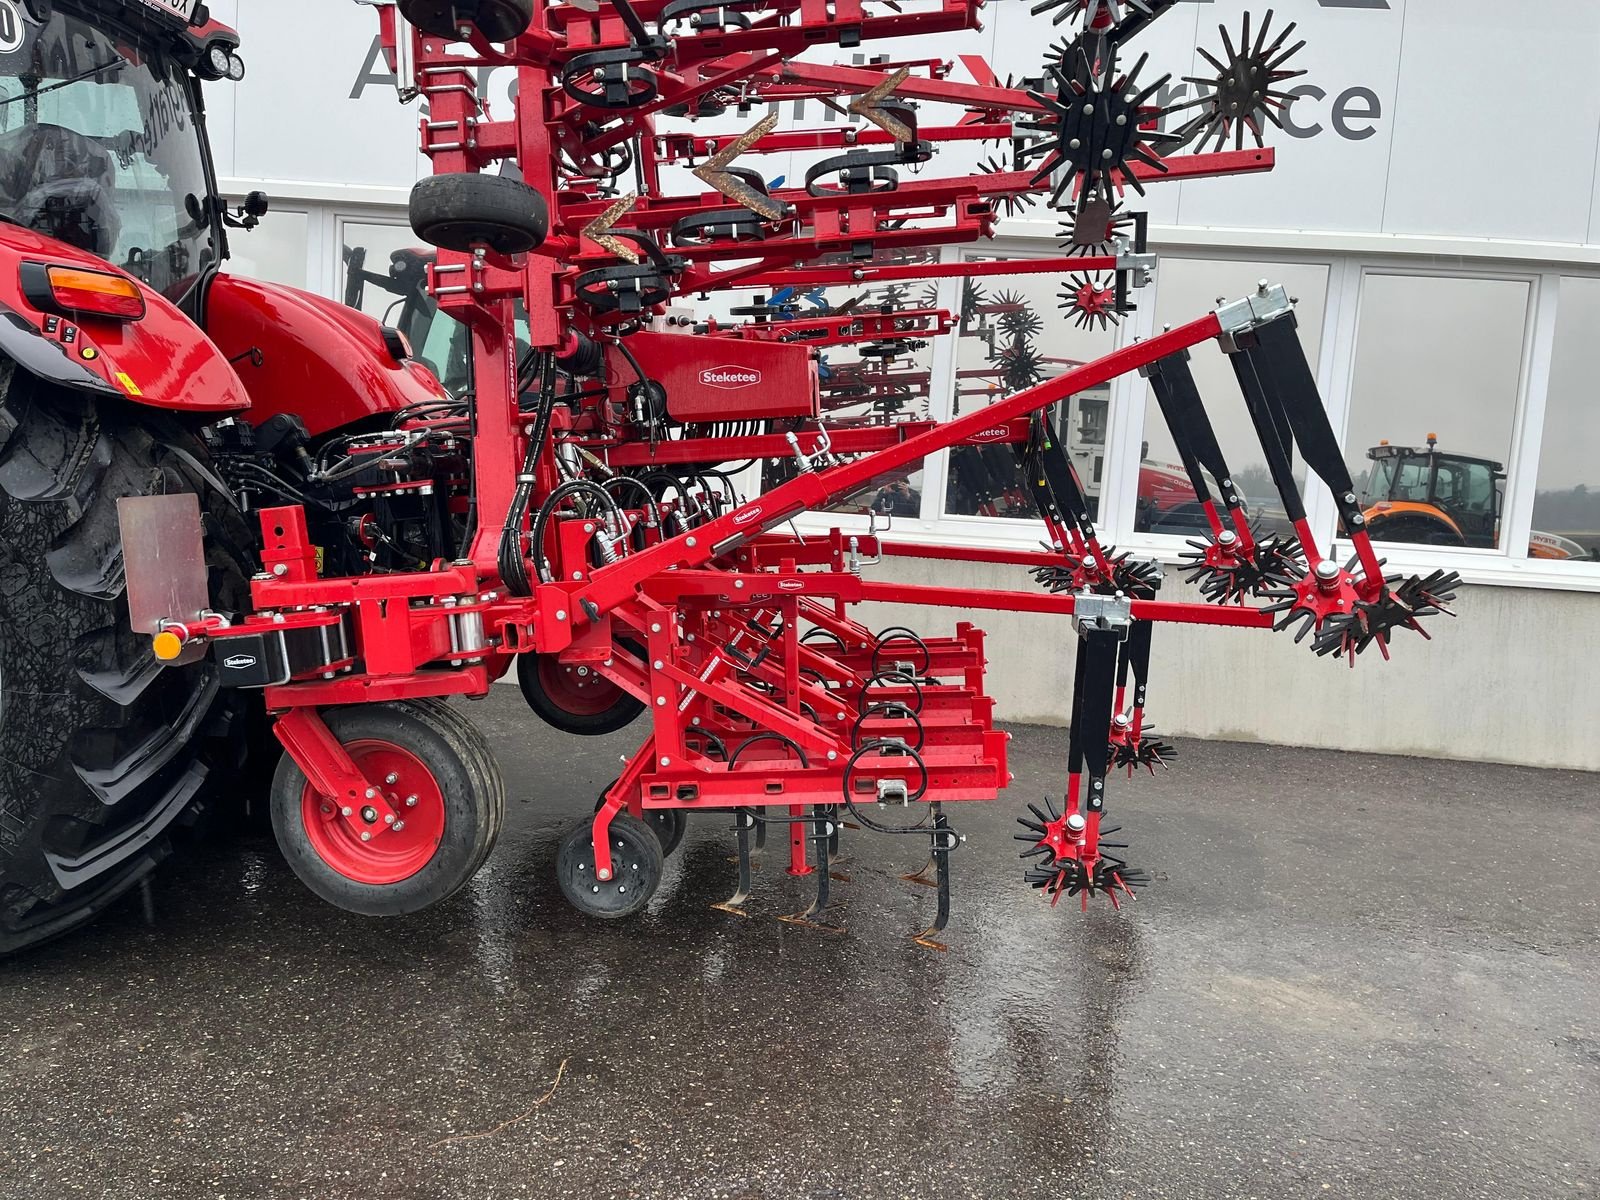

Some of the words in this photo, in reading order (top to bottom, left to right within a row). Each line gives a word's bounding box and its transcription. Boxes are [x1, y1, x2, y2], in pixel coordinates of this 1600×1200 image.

[703, 371, 757, 382] Steketee
[970, 429, 1006, 438] ketee
[735, 508, 760, 523] Steketee
[226, 658, 254, 666] Steketee
